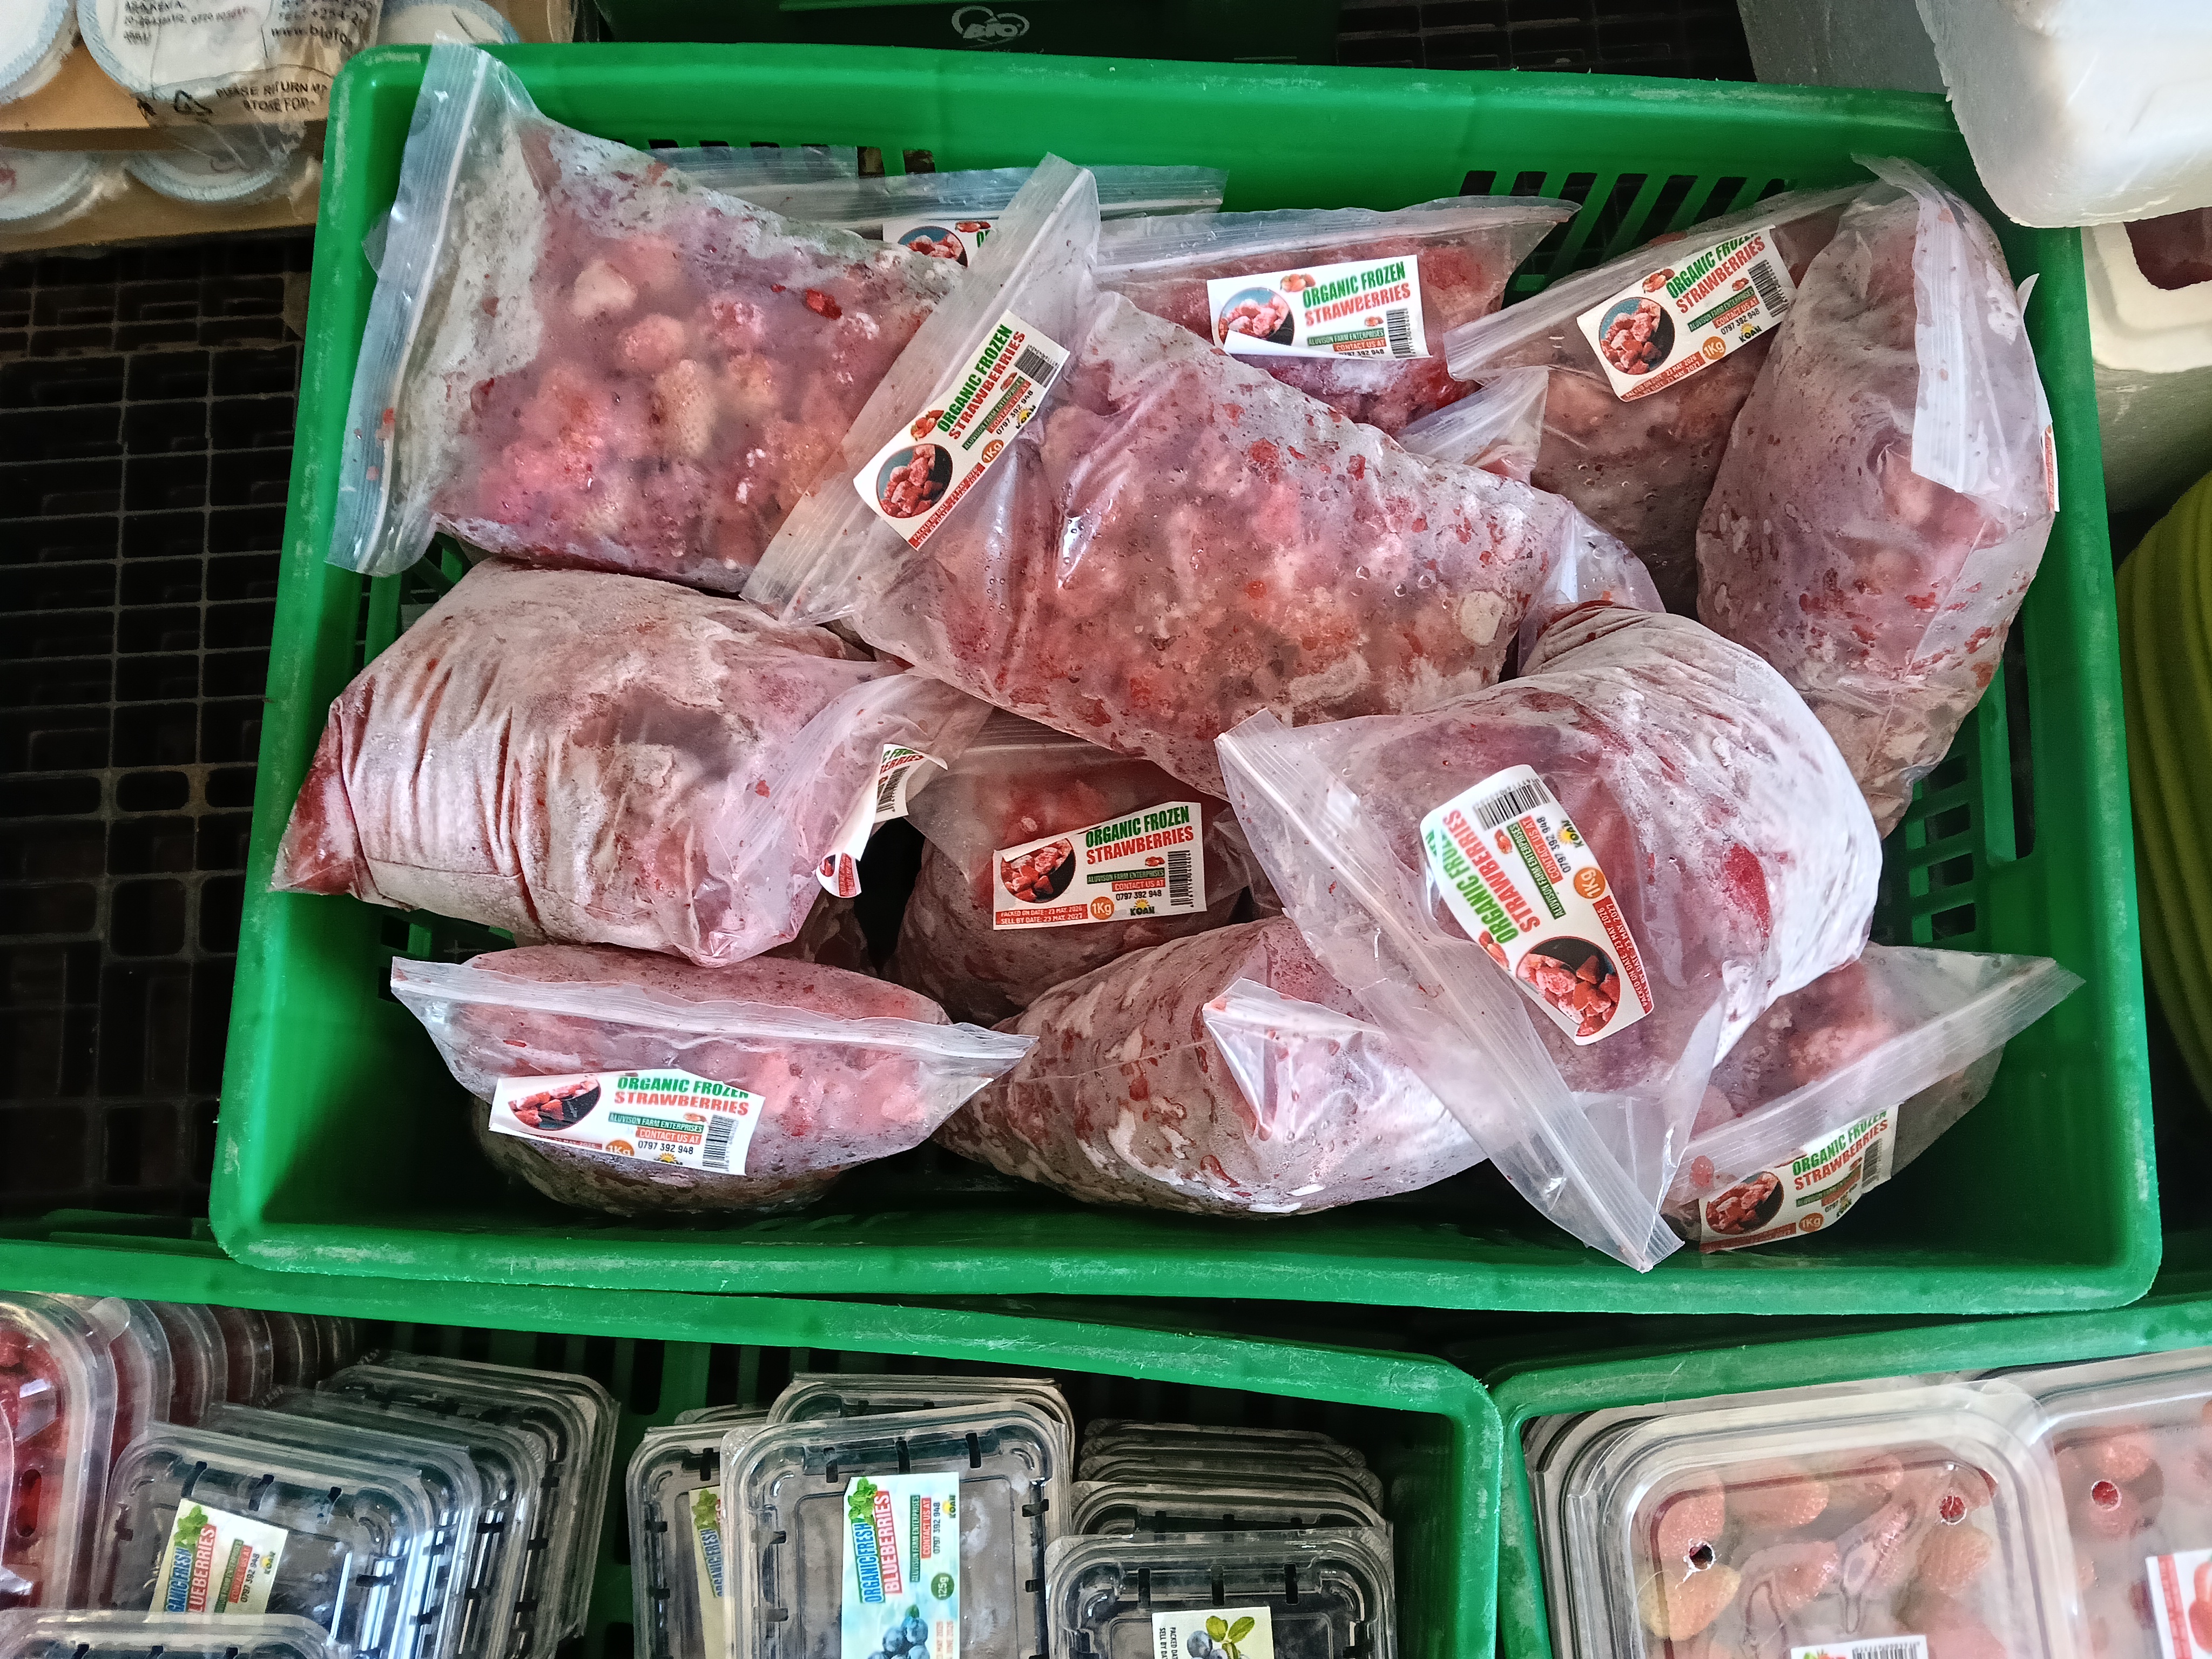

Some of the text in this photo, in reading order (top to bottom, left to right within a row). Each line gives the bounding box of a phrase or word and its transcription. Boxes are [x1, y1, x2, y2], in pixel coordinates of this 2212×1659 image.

[1666, 232, 1758, 298] ORGANIC FROZ
[1676, 236, 1766, 313] STRAWBERRIES
[1303, 261, 1406, 308] ORGANIC FROZEN
[1305, 283, 1411, 327] STRAWBERRIES
[1716, 298, 1758, 326] CONTACT US AT
[1721, 308, 1760, 335] 0797 392 948
[1739, 326, 1762, 342] KOAN
[1334, 334, 1348, 342] FARM
[1336, 342, 1365, 351] CONTACT
[1704, 341, 1724, 356] 1Kg
[937, 324, 1013, 432] ORGANIC FROZEN
[949, 332, 1025, 439] STRAWBERRIES
[990, 402, 1015, 430] CONTACT
[1014, 392, 1023, 402] US
[996, 390, 1034, 434] 0797 392 948
[983, 442, 1002, 461] 1Kg
[1086, 805, 1189, 848] ORGANIC FROZEN
[1562, 820, 1584, 848] KOAN
[1086, 825, 1193, 865] STRAWBERRIES
[1522, 819, 1559, 879] CONTACT US AT
[1537, 817, 1572, 873] 0797 392 948
[1088, 869, 1164, 882] ALUVISON FARM ENTERPRISES
[1443, 810, 1540, 934] STRAWBERRIES
[1509, 824, 1564, 916] ALUVISON FARM ENTERPRISES
[1581, 869, 1601, 897] 1Kg
[1115, 882, 1144, 891] CONTACT
[1092, 902, 1111, 915] 1Kg
[1130, 907, 1155, 916] KOAN
[1455, 875, 1519, 944] ORGANIC
[1597, 907, 1610, 925] 2026
[1606, 903, 1620, 922] 2027
[1614, 940, 1623, 950] 23
[1624, 940, 1633, 950] 23
[1629, 972, 1637, 981] ON
[1634, 980, 1648, 1007] PACKED
[617, 1077, 689, 1092] ORGANIC
[615, 1091, 750, 1115] STRAWBERRIES
[610, 1114, 703, 1132] ALUVISON FARM ENTERPRISES
[640, 1129, 700, 1144] CONTACT US AT
[638, 1141, 693, 1154] 0797 392 948
[1792, 1133, 1847, 1176] ORGANIC
[1794, 1120, 1887, 1190] STRAWBERRIES
[1802, 1217, 1820, 1228] 1Kg
[923, 1500, 930, 1508] AT
[923, 1510, 930, 1520] US
[874, 1495, 900, 1592] BLUEBERRIES
[188, 1527, 215, 1612] LUEBERRIES
[854, 1523, 882, 1602] ORGANIC FRESH
[167, 1581, 187, 1612] GANIC
[938, 1576, 949, 1597] 125g
